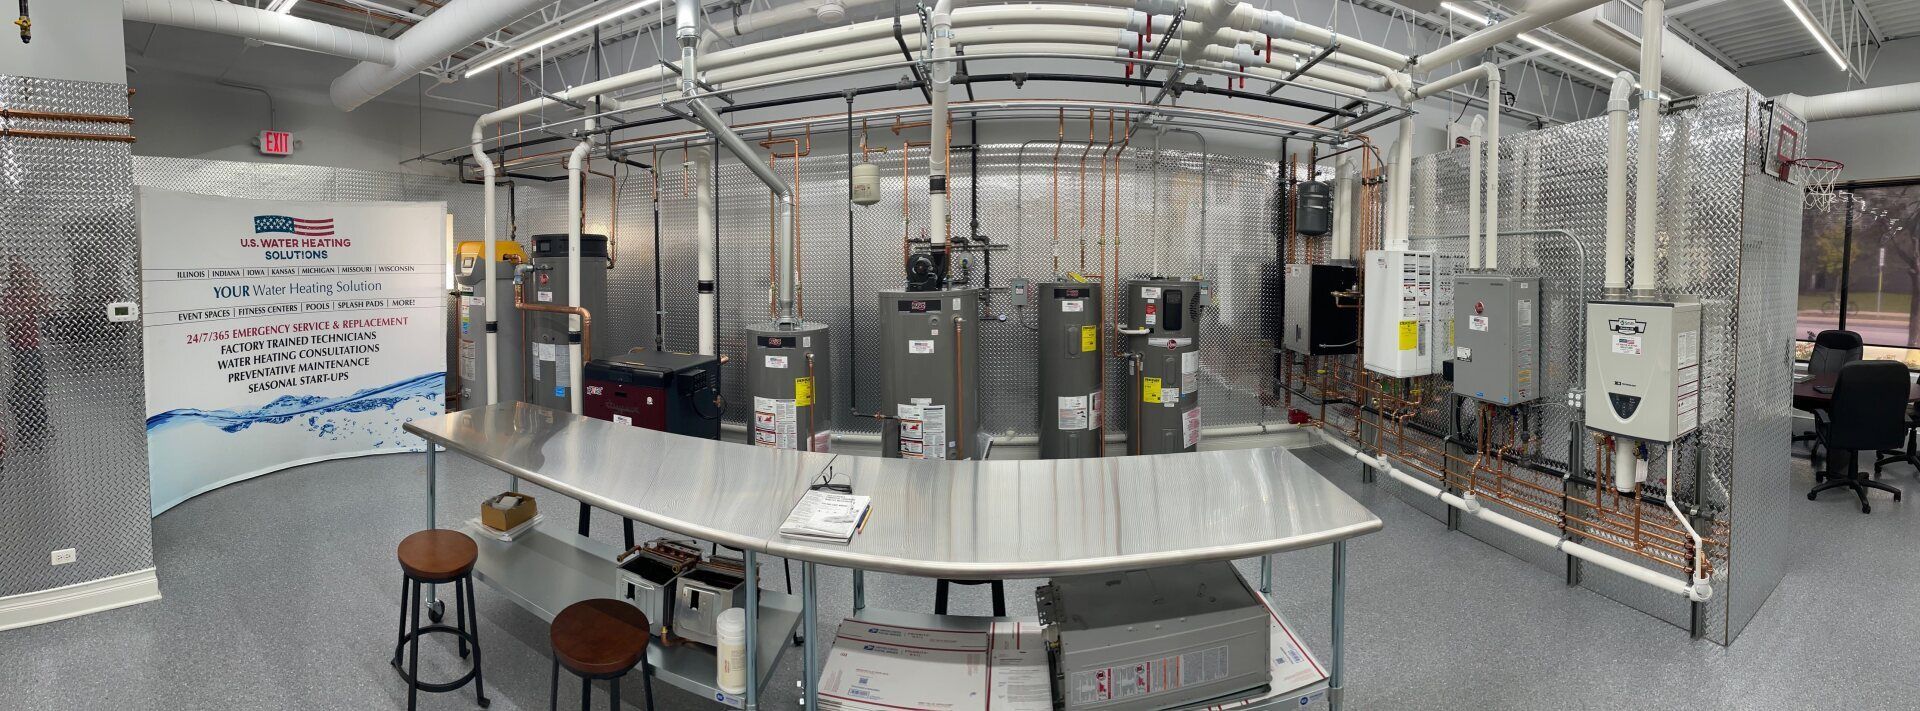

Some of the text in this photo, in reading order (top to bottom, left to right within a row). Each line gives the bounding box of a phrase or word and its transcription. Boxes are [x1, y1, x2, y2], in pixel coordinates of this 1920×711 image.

[266, 131, 289, 152] EXIT
[241, 239, 350, 247] U.S. WATER HEATING
[265, 251, 328, 260] SOLUTIONS
[214, 280, 382, 298] YOUR Water Heating Solution
[179, 312, 202, 321] EVENT
[204, 310, 230, 319] SPACES
[239, 307, 265, 315] FITNESS
[268, 305, 297, 313] CENTERS
[187, 317, 408, 344] 24/7/365 EMERGENCY SERVICE & REPLACEMENT
[221, 331, 376, 354] FACTORY TRAINED TECHNICIANS
[218, 344, 379, 369] WATER HEATING CONSULTATIONS
[228, 357, 369, 382] PREVENTATIVE MAINTENANCE
[248, 372, 348, 393] SEASONAL START-UPS
